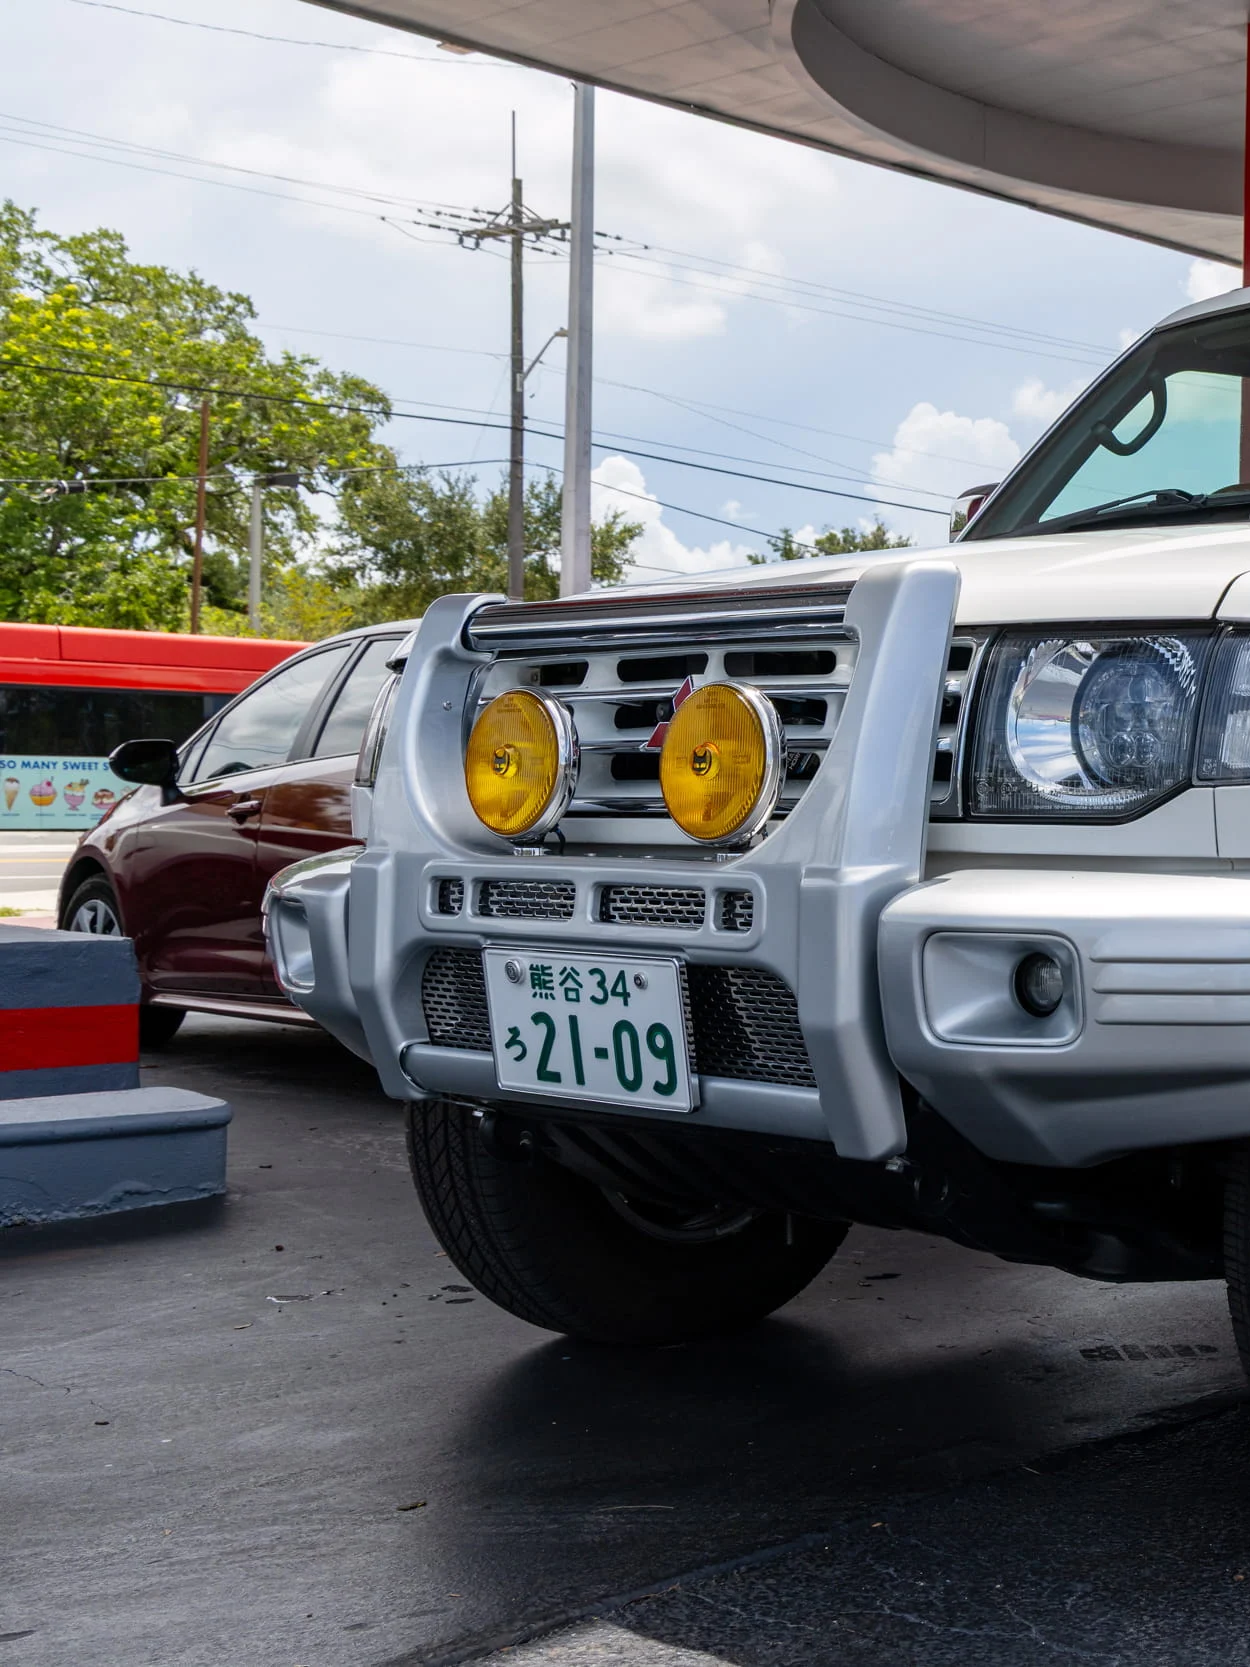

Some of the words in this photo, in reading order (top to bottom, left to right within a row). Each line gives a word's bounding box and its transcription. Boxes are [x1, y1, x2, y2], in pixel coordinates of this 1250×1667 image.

[0, 760, 17, 769] SO
[21, 760, 58, 770] MANY
[62, 761, 99, 771] SWEET
[530, 1011, 678, 1097] 21-09
